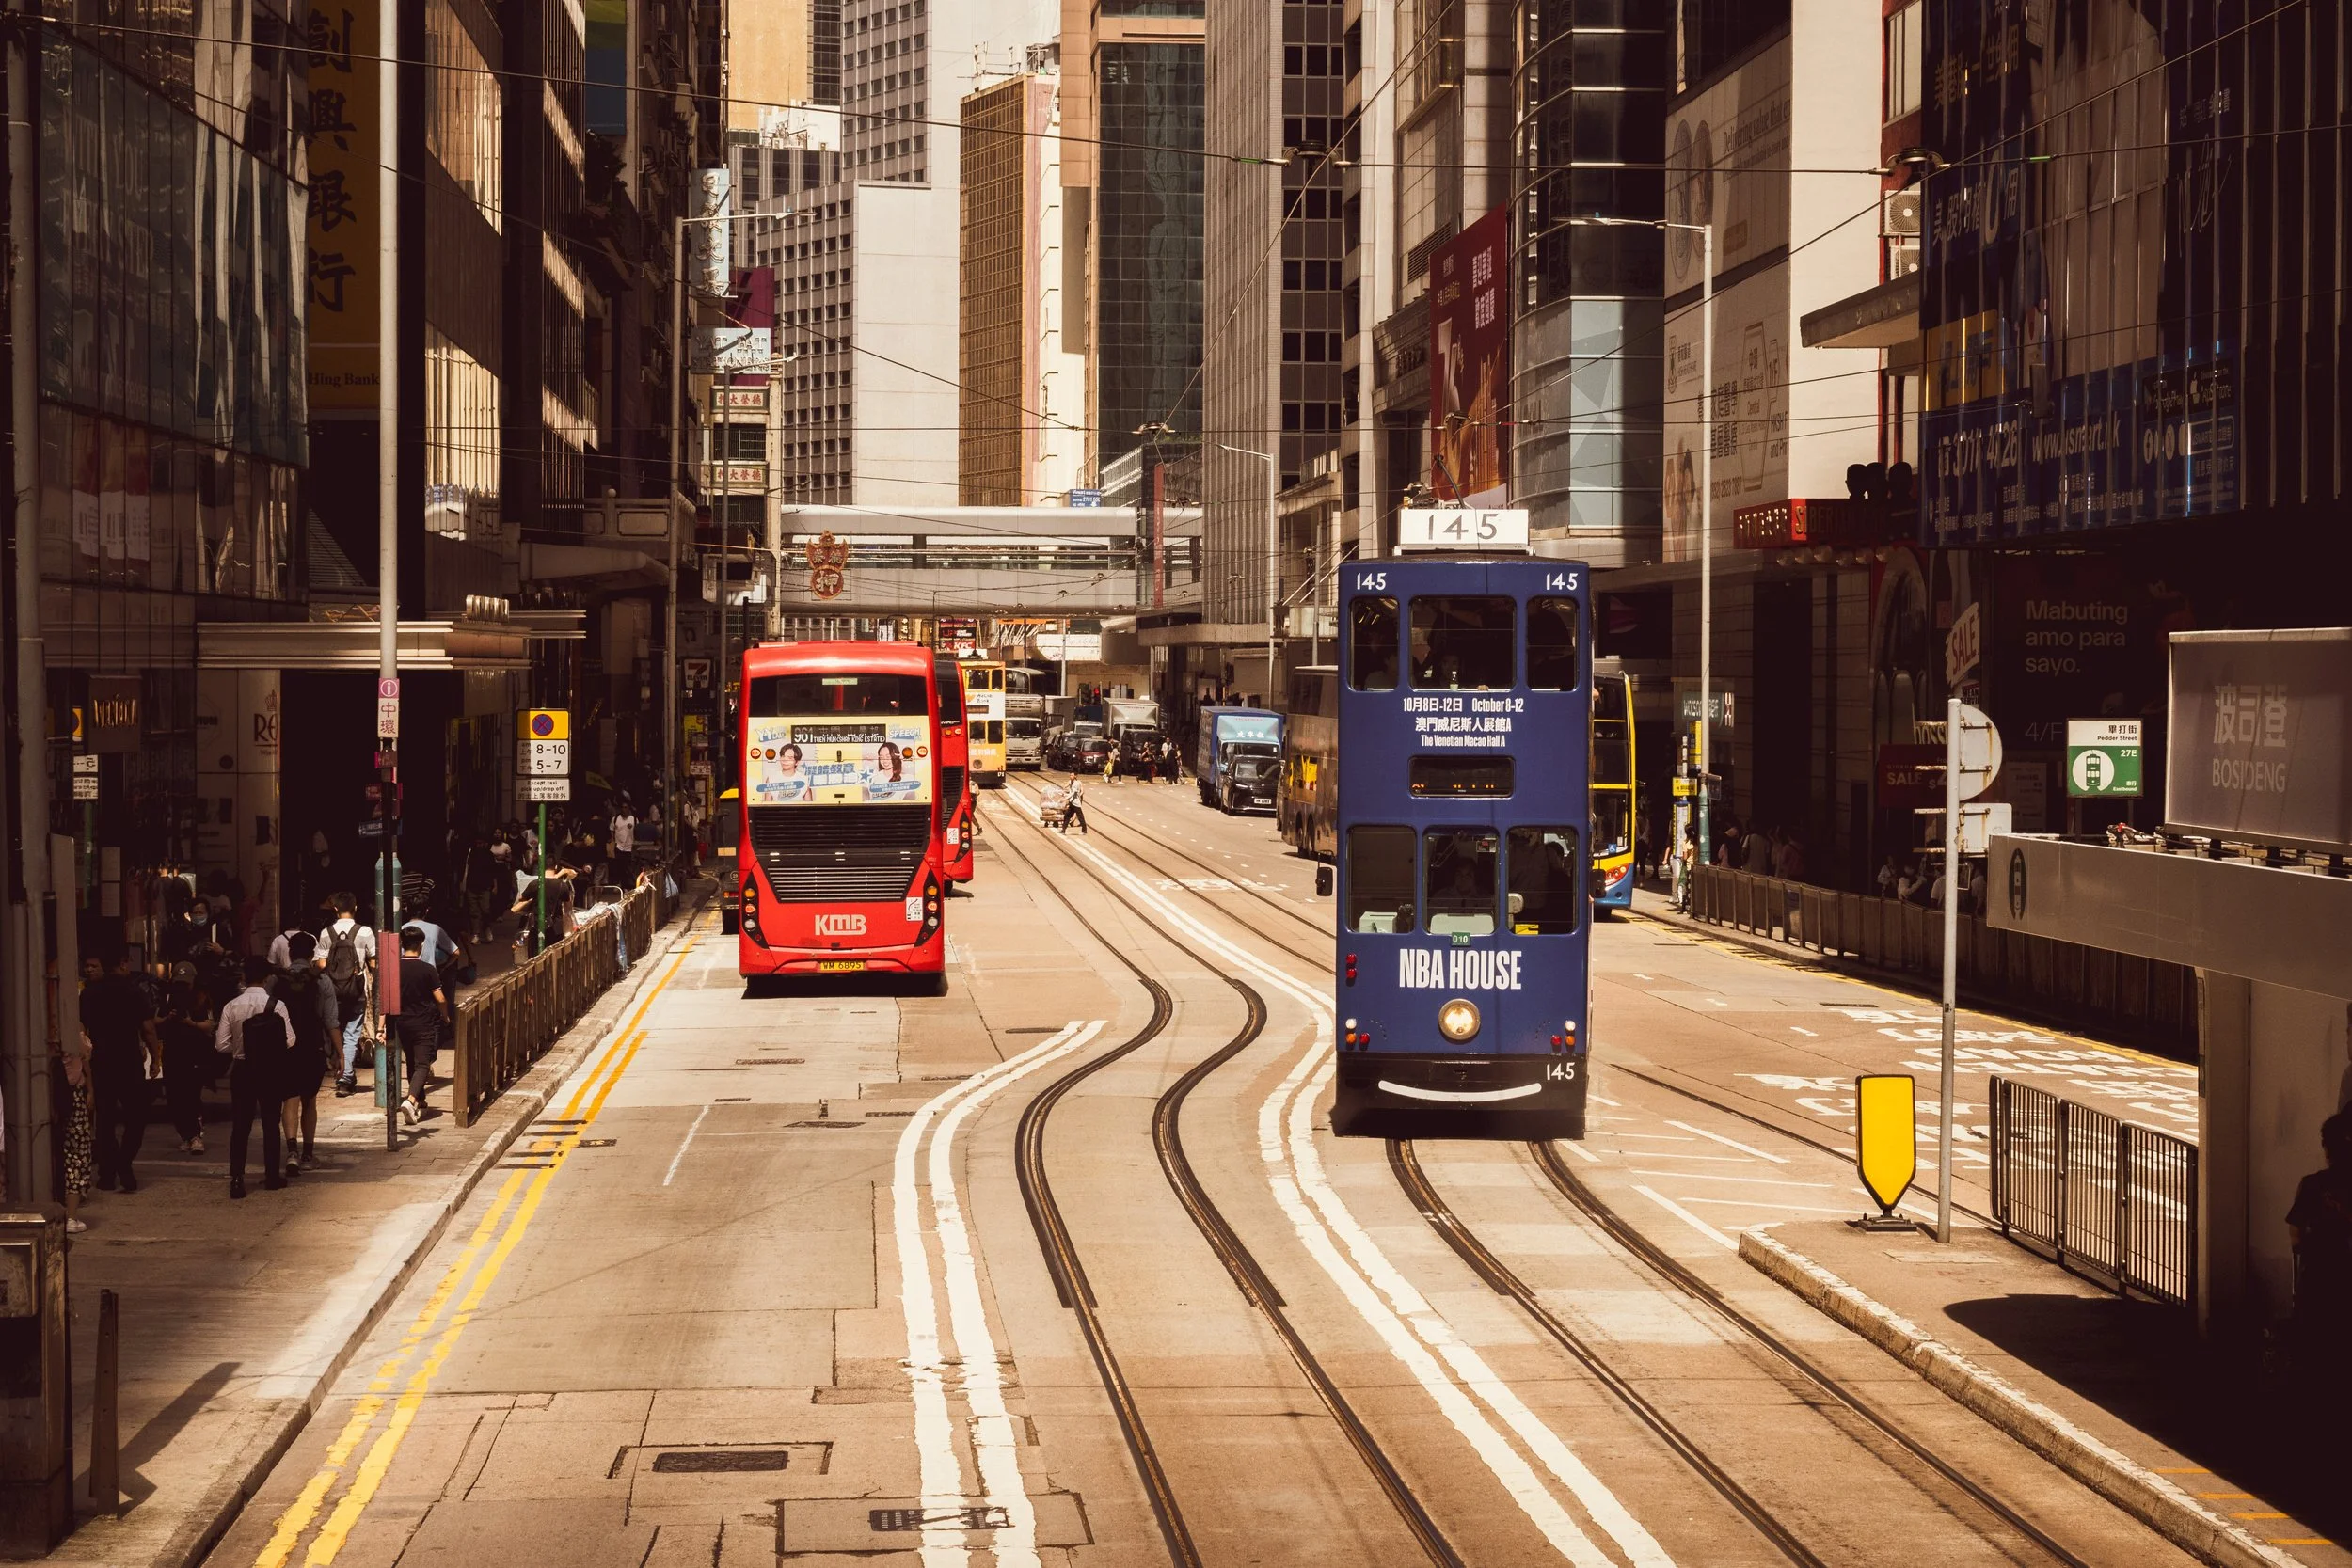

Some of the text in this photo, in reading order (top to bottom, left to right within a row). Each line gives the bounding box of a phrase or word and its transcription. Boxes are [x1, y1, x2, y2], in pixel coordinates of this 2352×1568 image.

[343, 372, 380, 386] Bank
[1428, 514, 1499, 540] 145
[1356, 572, 1387, 591] 145
[1546, 572, 1579, 591] 145
[2026, 600, 2128, 625] Mabuting
[2025, 631, 2126, 651] amo para
[2025, 657, 2081, 677] sayo.
[1404, 697, 1463, 712] 10月8日-12日
[1472, 697, 1524, 712] October 8-12
[381, 702, 396, 735] 中環
[1415, 717, 1512, 732] 澳門威尼斯人展館A
[2213, 682, 2288, 748] 波司登
[814, 734, 827, 743] TUEN
[2025, 721, 2063, 742] 4/F
[2108, 724, 2137, 734] 畢打街
[536, 744, 566, 754] 8-10
[1421, 735, 1505, 747] The Venetian Macao Hall A
[1887, 772, 1923, 785] SALE
[2212, 758, 2286, 793] BOSIDENG
[815, 914, 867, 935] KMB
[1452, 935, 1469, 943] 010
[823, 961, 863, 970] WM 6895
[1399, 948, 1522, 990] NBA HOUSE
[1546, 1062, 1575, 1081] 145
